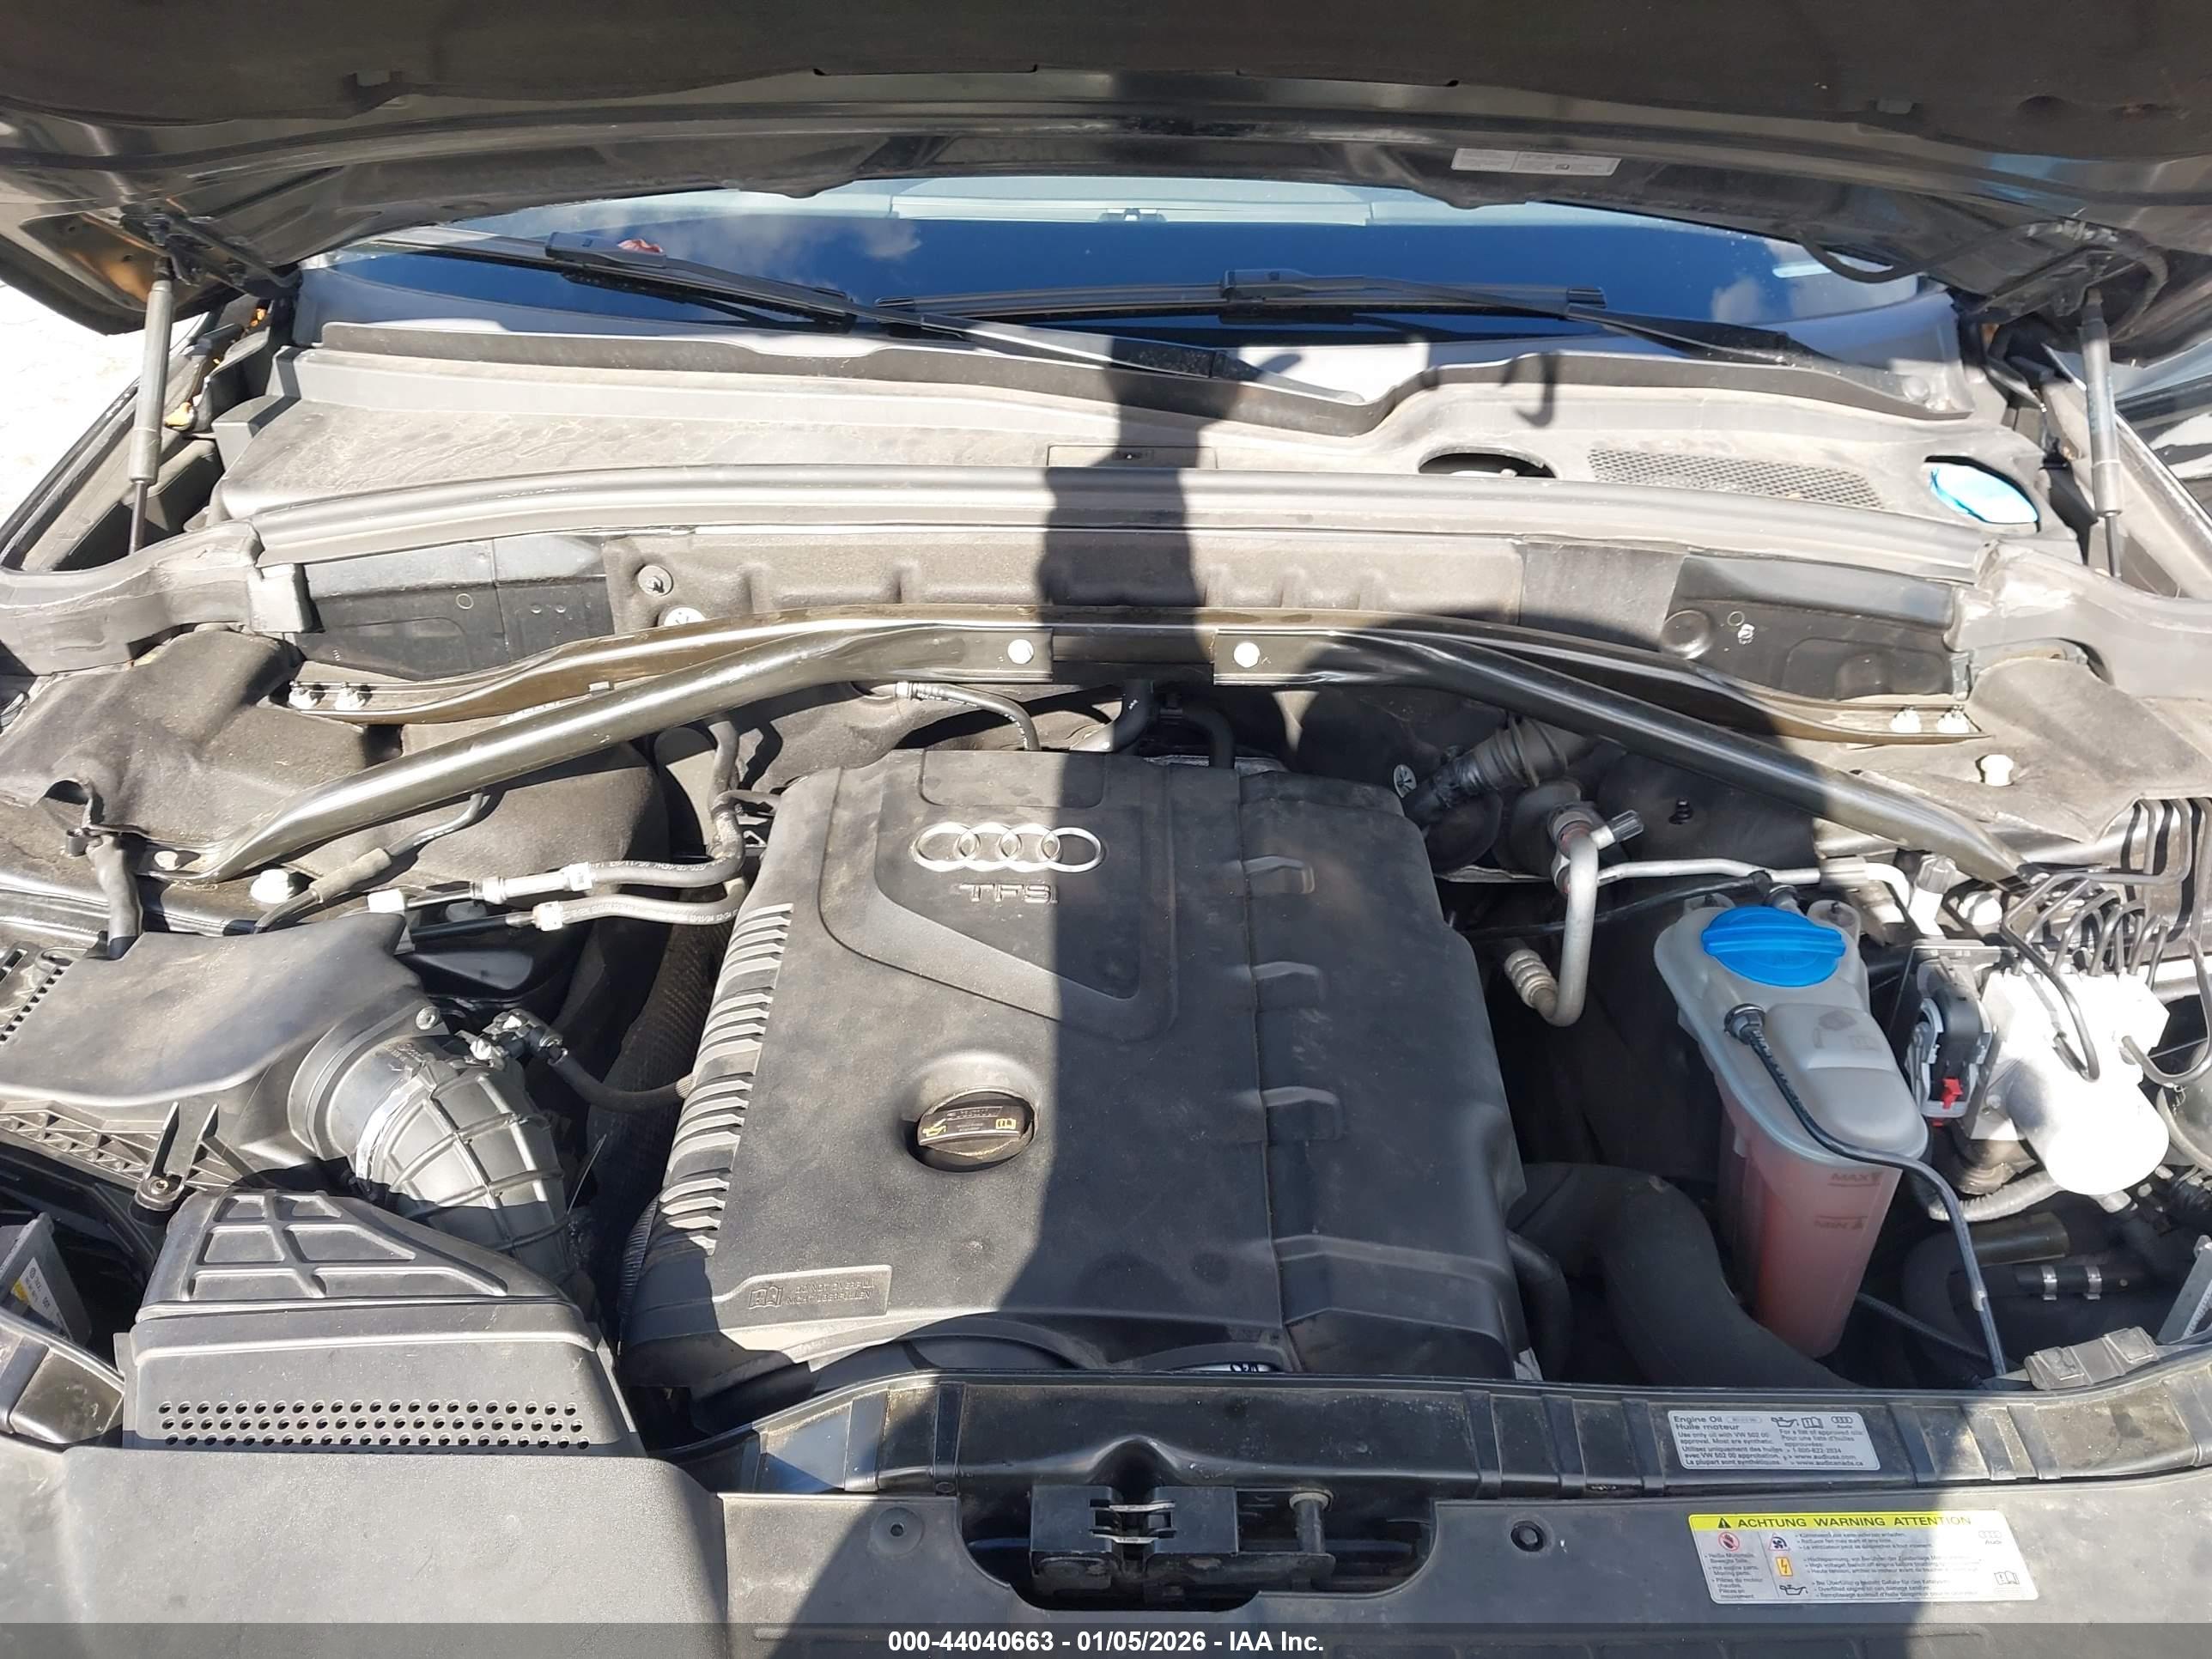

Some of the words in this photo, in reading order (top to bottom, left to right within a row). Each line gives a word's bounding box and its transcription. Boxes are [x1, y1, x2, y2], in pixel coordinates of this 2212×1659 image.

[960, 882, 1059, 903] TFSI
[1674, 1416, 1707, 1425] Engine
[1737, 1518, 1808, 1528] ACHTUNG
[1814, 1517, 1886, 1527] WARNING
[1893, 1516, 1972, 1526] ATTENTION
